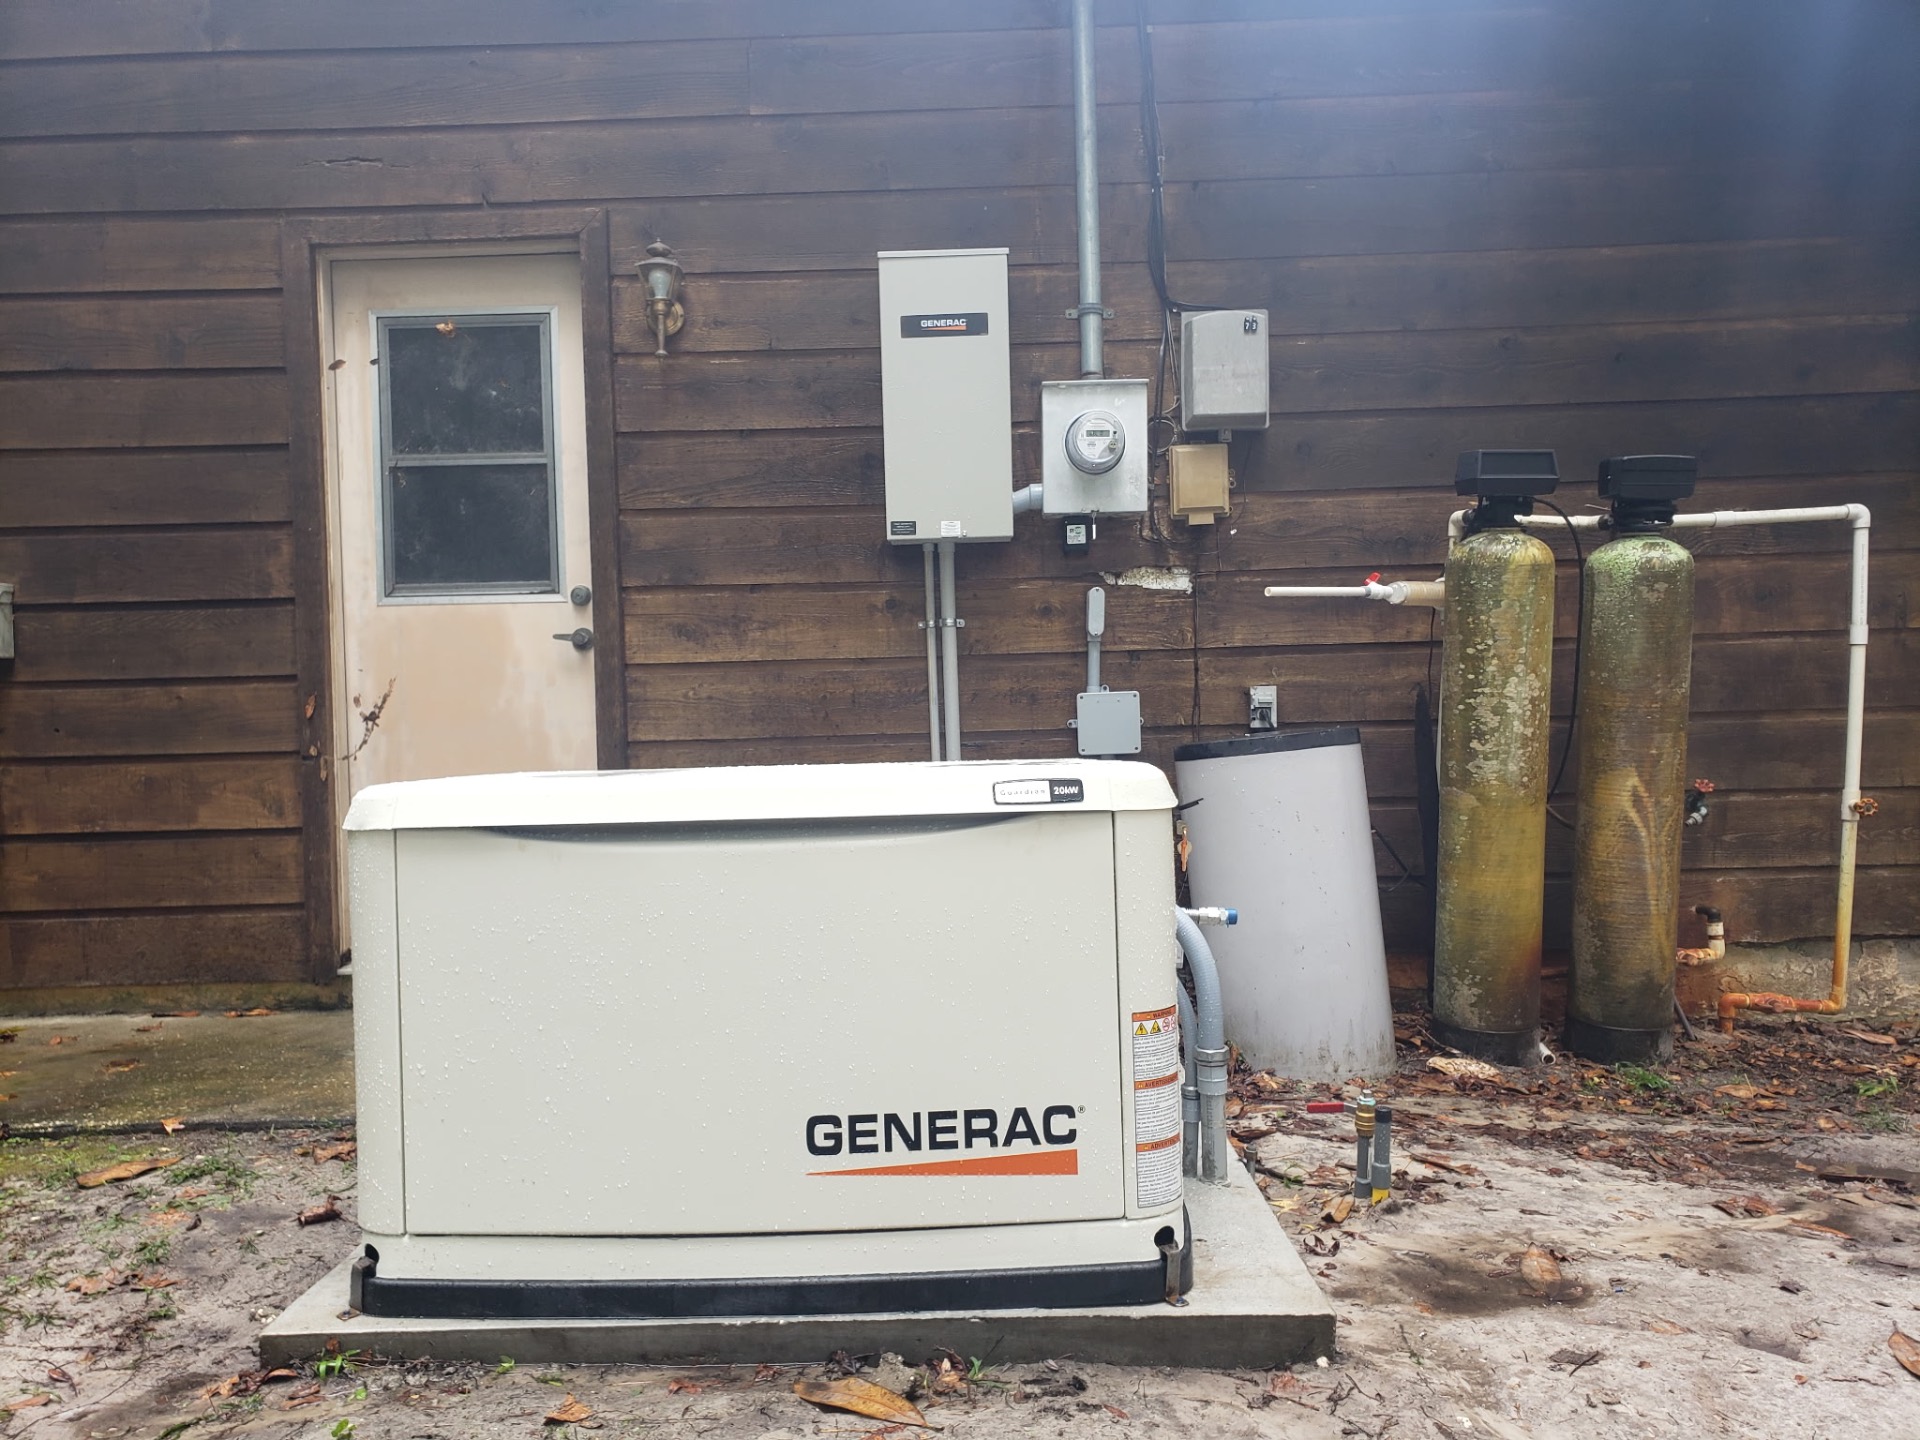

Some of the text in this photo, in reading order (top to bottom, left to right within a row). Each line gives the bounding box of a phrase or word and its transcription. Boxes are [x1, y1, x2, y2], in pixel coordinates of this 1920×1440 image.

[920, 318, 967, 328] GENERAC
[999, 785, 1079, 796] Guardian 20kW
